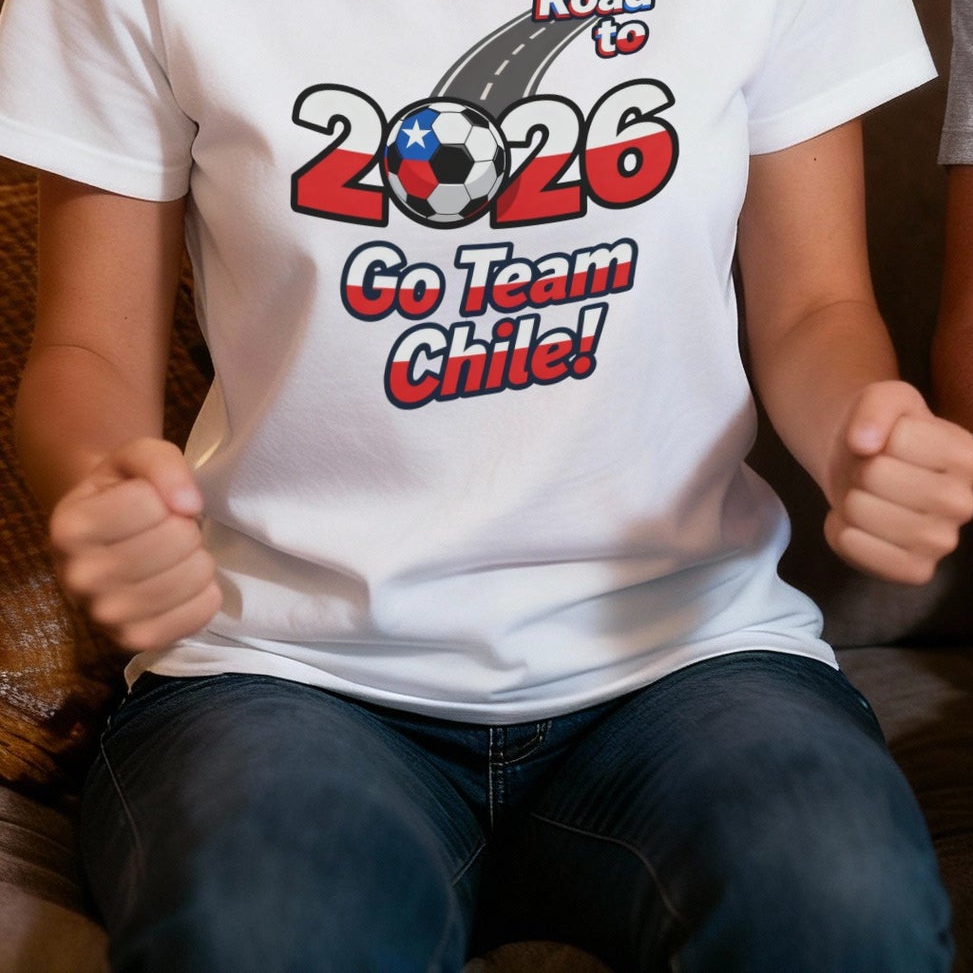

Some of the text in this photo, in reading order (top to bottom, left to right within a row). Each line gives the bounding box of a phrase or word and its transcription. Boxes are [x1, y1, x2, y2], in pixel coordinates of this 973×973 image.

[592, 17, 649, 58] to
[340, 238, 638, 322] Go Team
[384, 302, 609, 410] Chile!
